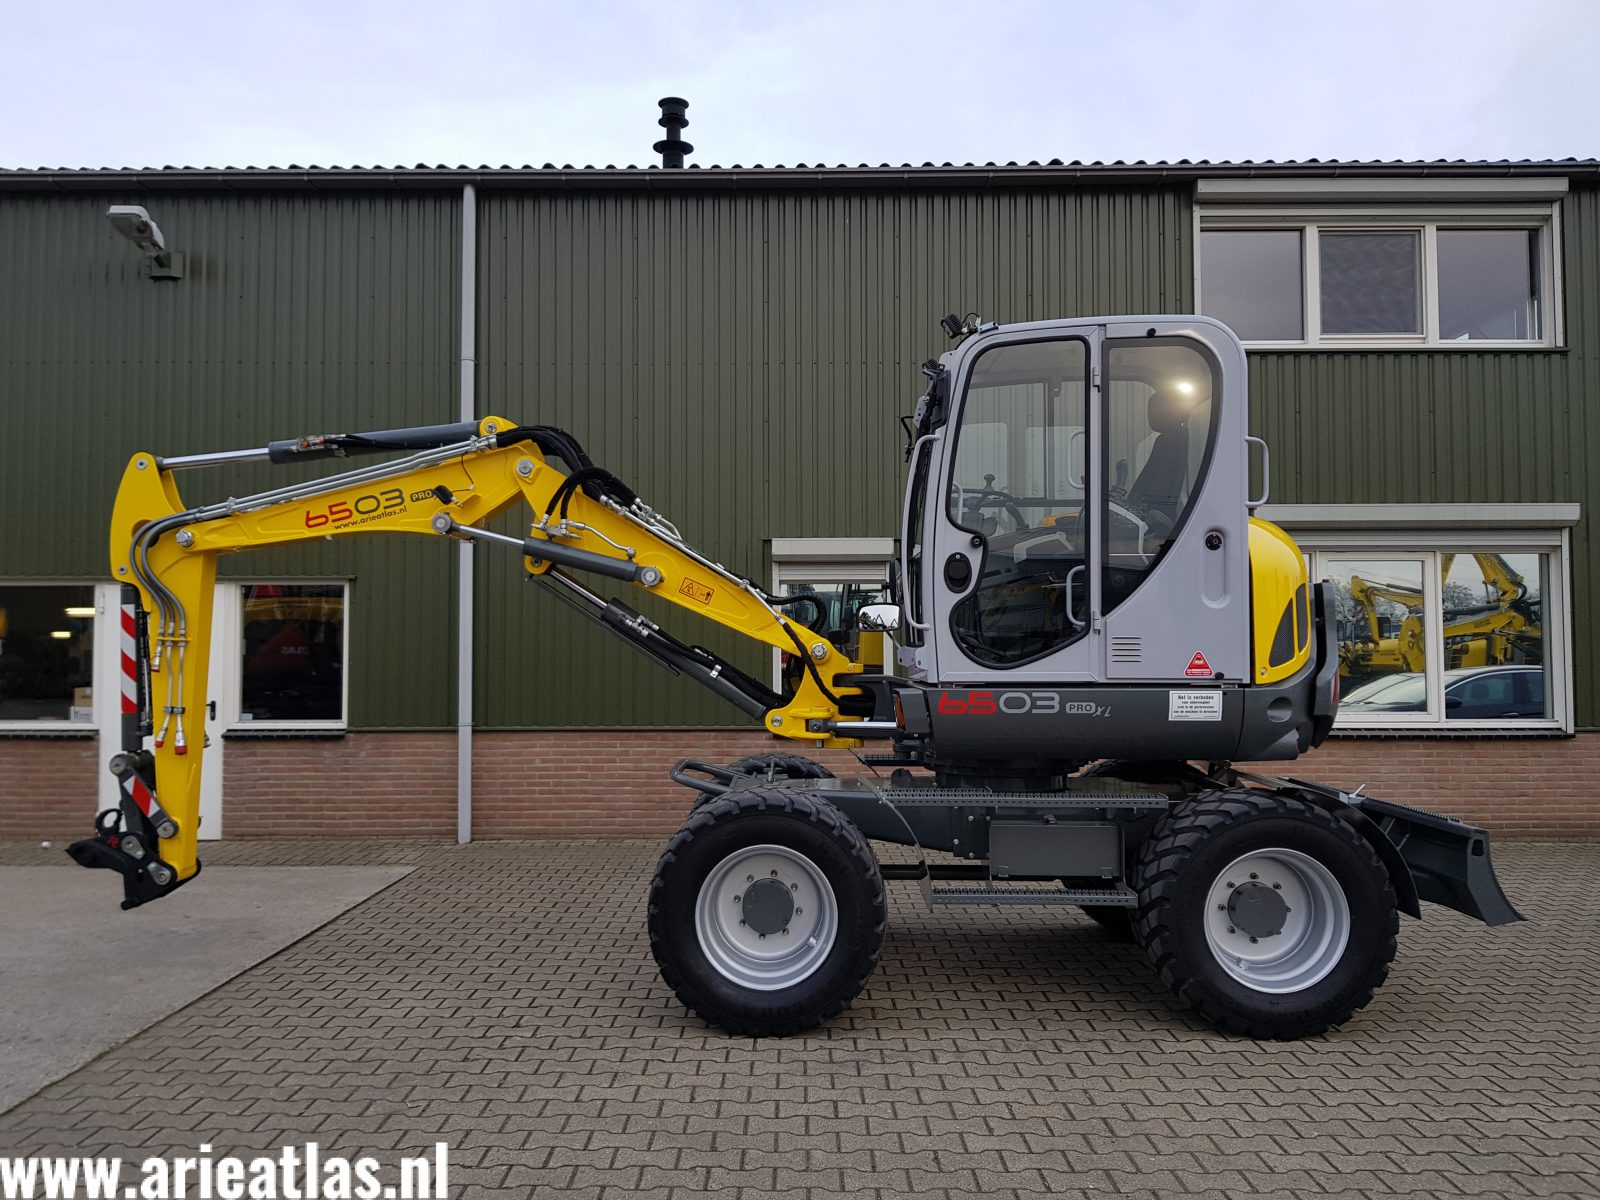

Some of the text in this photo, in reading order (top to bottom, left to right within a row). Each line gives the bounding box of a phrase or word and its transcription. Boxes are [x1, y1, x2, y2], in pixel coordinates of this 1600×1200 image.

[305, 488, 433, 528] 6503 PRO
[334, 505, 407, 530] www.arieatlas.nl
[939, 692, 1060, 714] 6503
[1069, 703, 1093, 712] PRO
